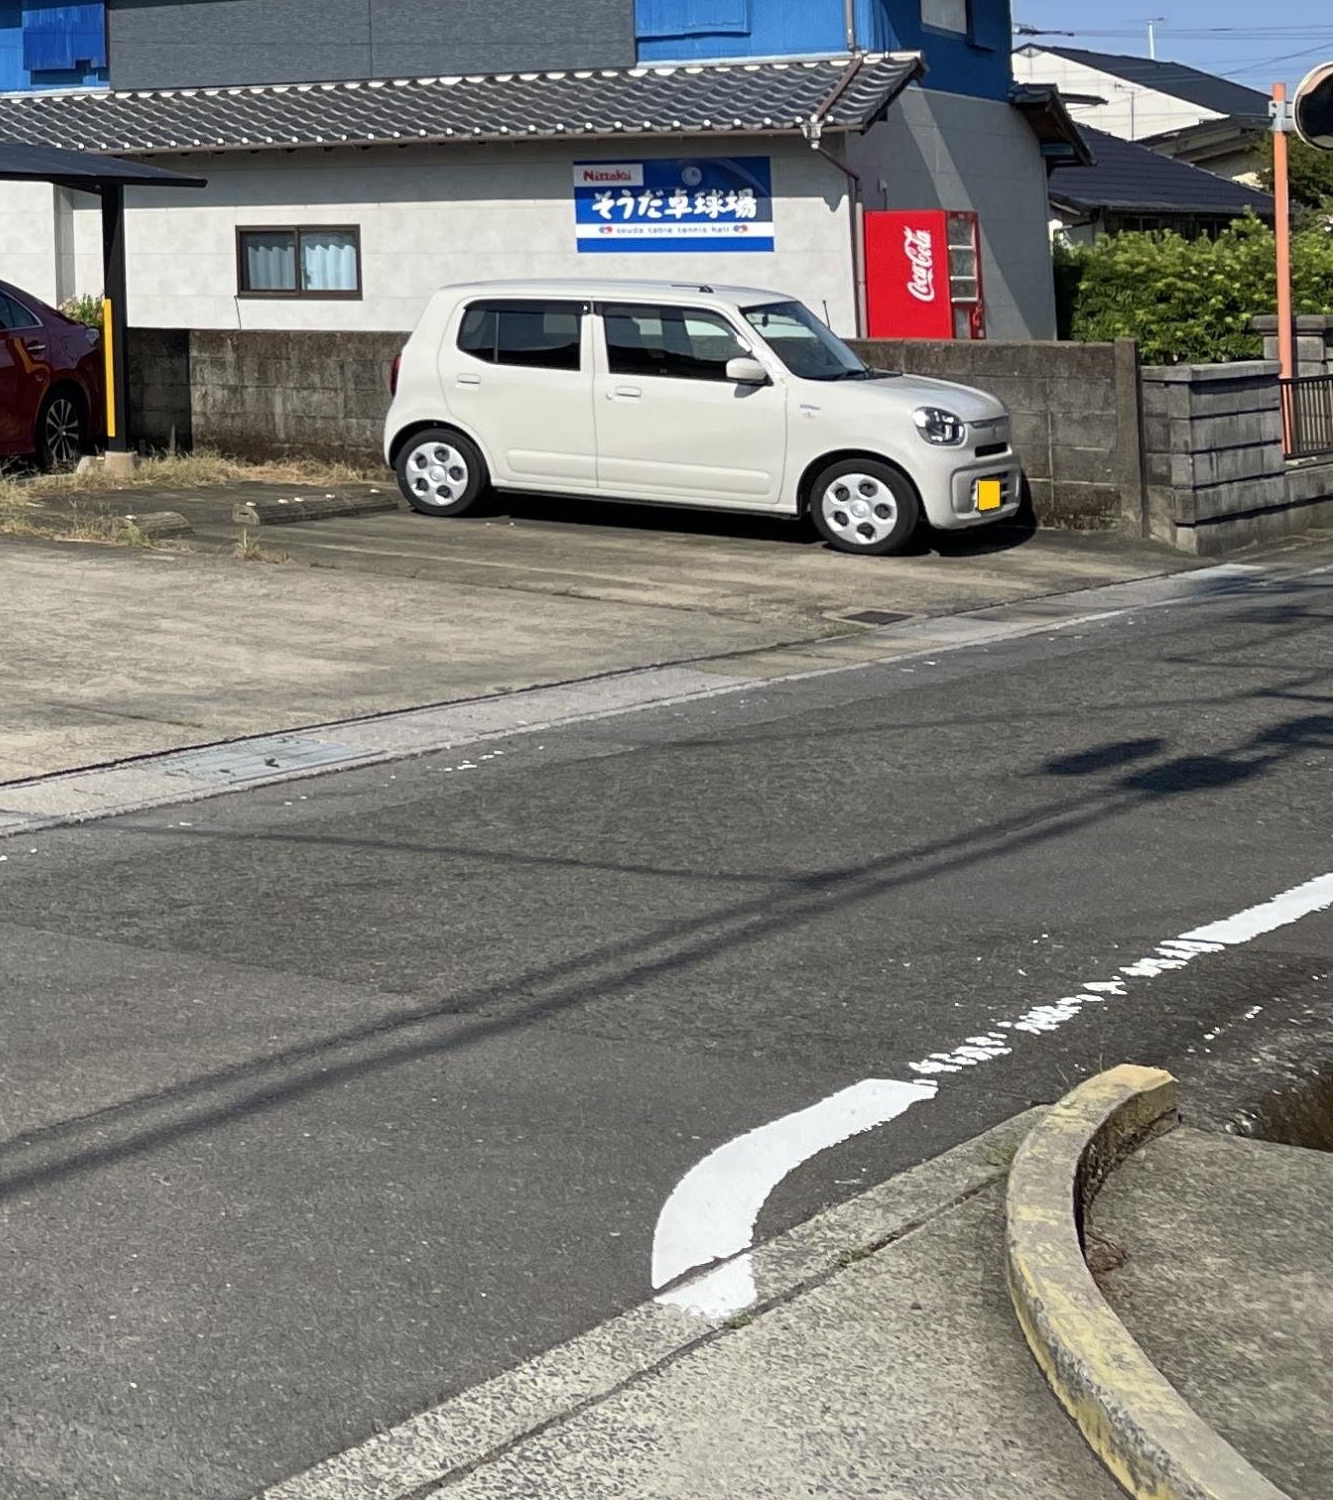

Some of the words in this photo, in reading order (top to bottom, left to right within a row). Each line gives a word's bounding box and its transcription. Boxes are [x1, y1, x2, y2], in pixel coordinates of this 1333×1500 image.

[583, 169, 632, 182] Nittaku
[592, 188, 758, 220] そうだ卓球場
[648, 226, 673, 234] table
[677, 226, 708, 234] tennis
[711, 225, 730, 234] hall
[903, 226, 935, 302] Coca-Cola
